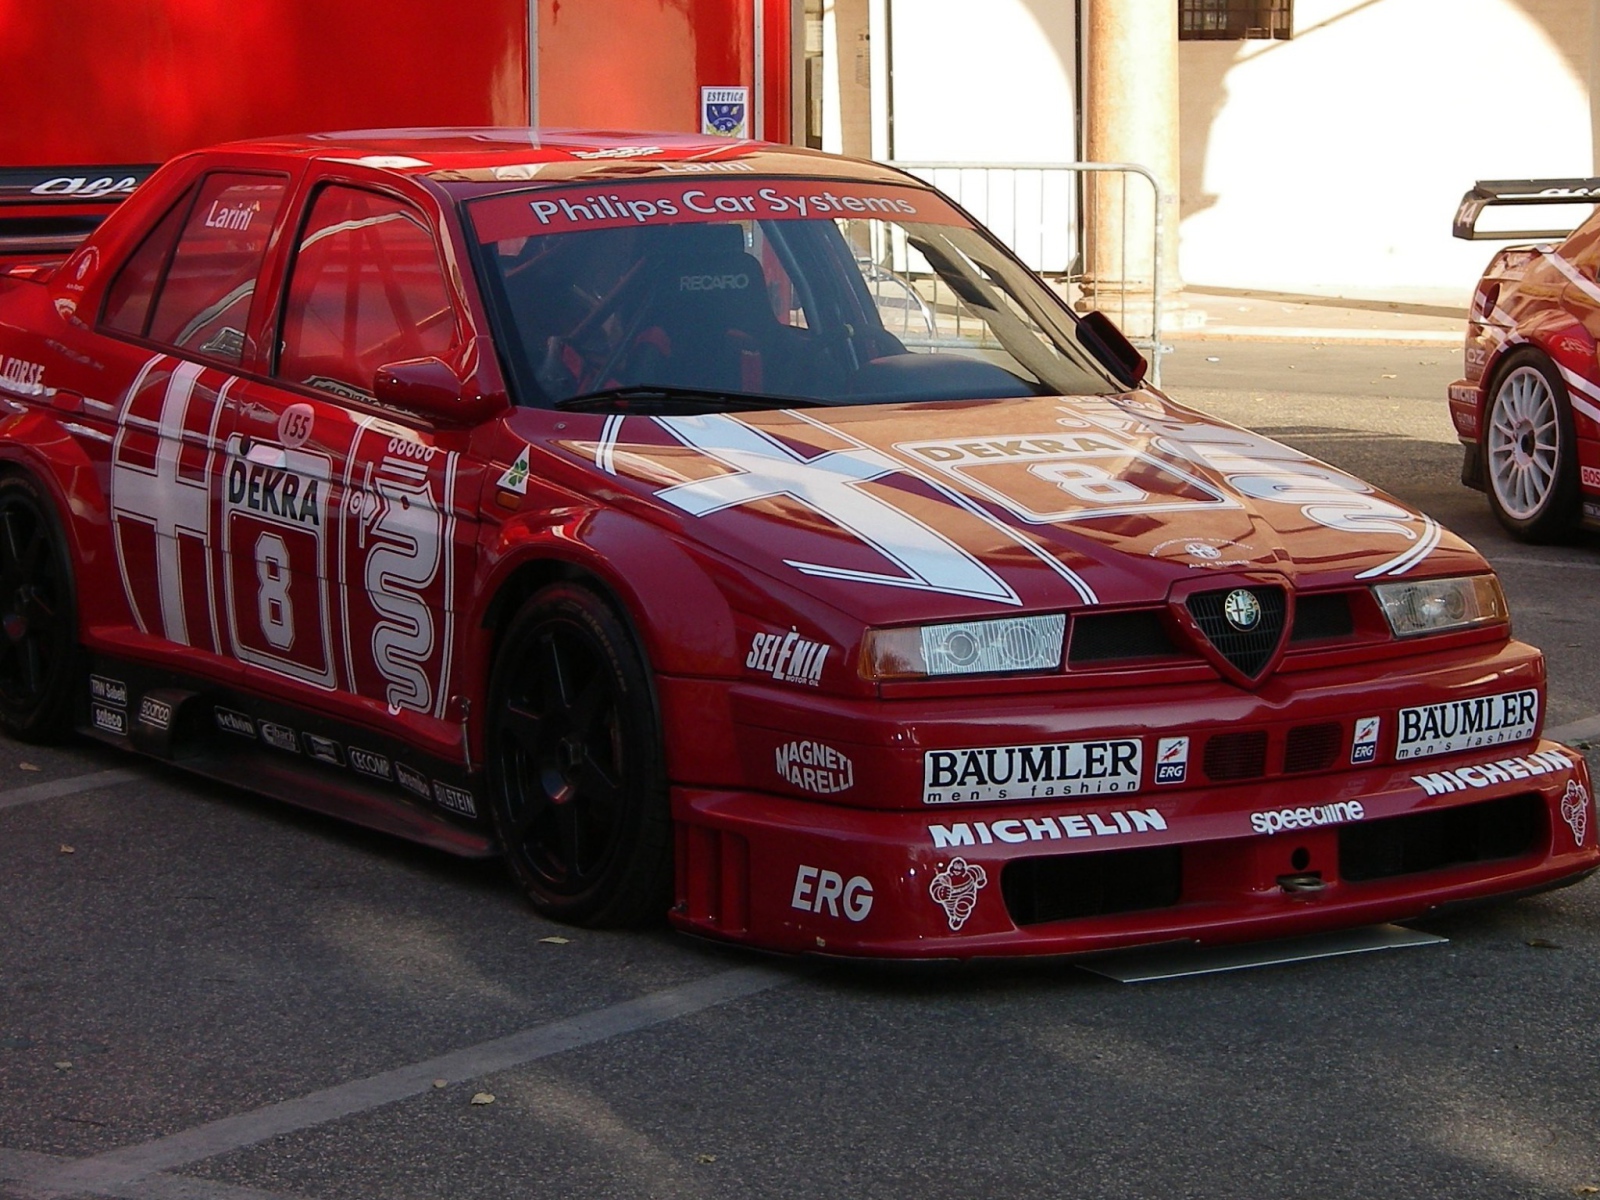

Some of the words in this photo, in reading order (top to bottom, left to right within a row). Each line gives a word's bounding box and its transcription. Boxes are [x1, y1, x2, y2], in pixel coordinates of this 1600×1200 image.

[706, 91, 744, 102] ESTETICA
[657, 162, 755, 172] Larini
[205, 200, 254, 230] Larini
[530, 195, 679, 224] Philips
[682, 190, 757, 214] Car
[758, 188, 917, 217] Systems
[1458, 202, 1478, 228] 14
[680, 274, 750, 291] RECARO
[4, 357, 45, 388] CORSE
[284, 412, 311, 440] 155
[913, 437, 1123, 462] DEKRA
[228, 458, 320, 526] DEKRA
[1027, 461, 1150, 504] 8
[255, 530, 295, 652] 8
[785, 675, 807, 685] MOTOR
[808, 679, 819, 687] OIL
[142, 700, 170, 721] sparco
[1401, 691, 1536, 744] BÄUMLER
[1354, 744, 1374, 758] ERG
[1399, 740, 1452, 758] men's
[1466, 728, 1534, 748] fashion
[351, 750, 390, 778] CECOMP
[775, 741, 854, 781] MAGNETI
[776, 756, 854, 794] MARELLI
[928, 741, 1139, 788] BÄUMLER
[1158, 765, 1184, 778] ERG
[1411, 749, 1575, 797] MICHELIN
[434, 783, 476, 815] BILSTEIN
[927, 788, 1008, 802] men's
[1031, 780, 1137, 798] fashion
[928, 808, 1169, 849] MICHELIN
[791, 864, 874, 922] ERG
